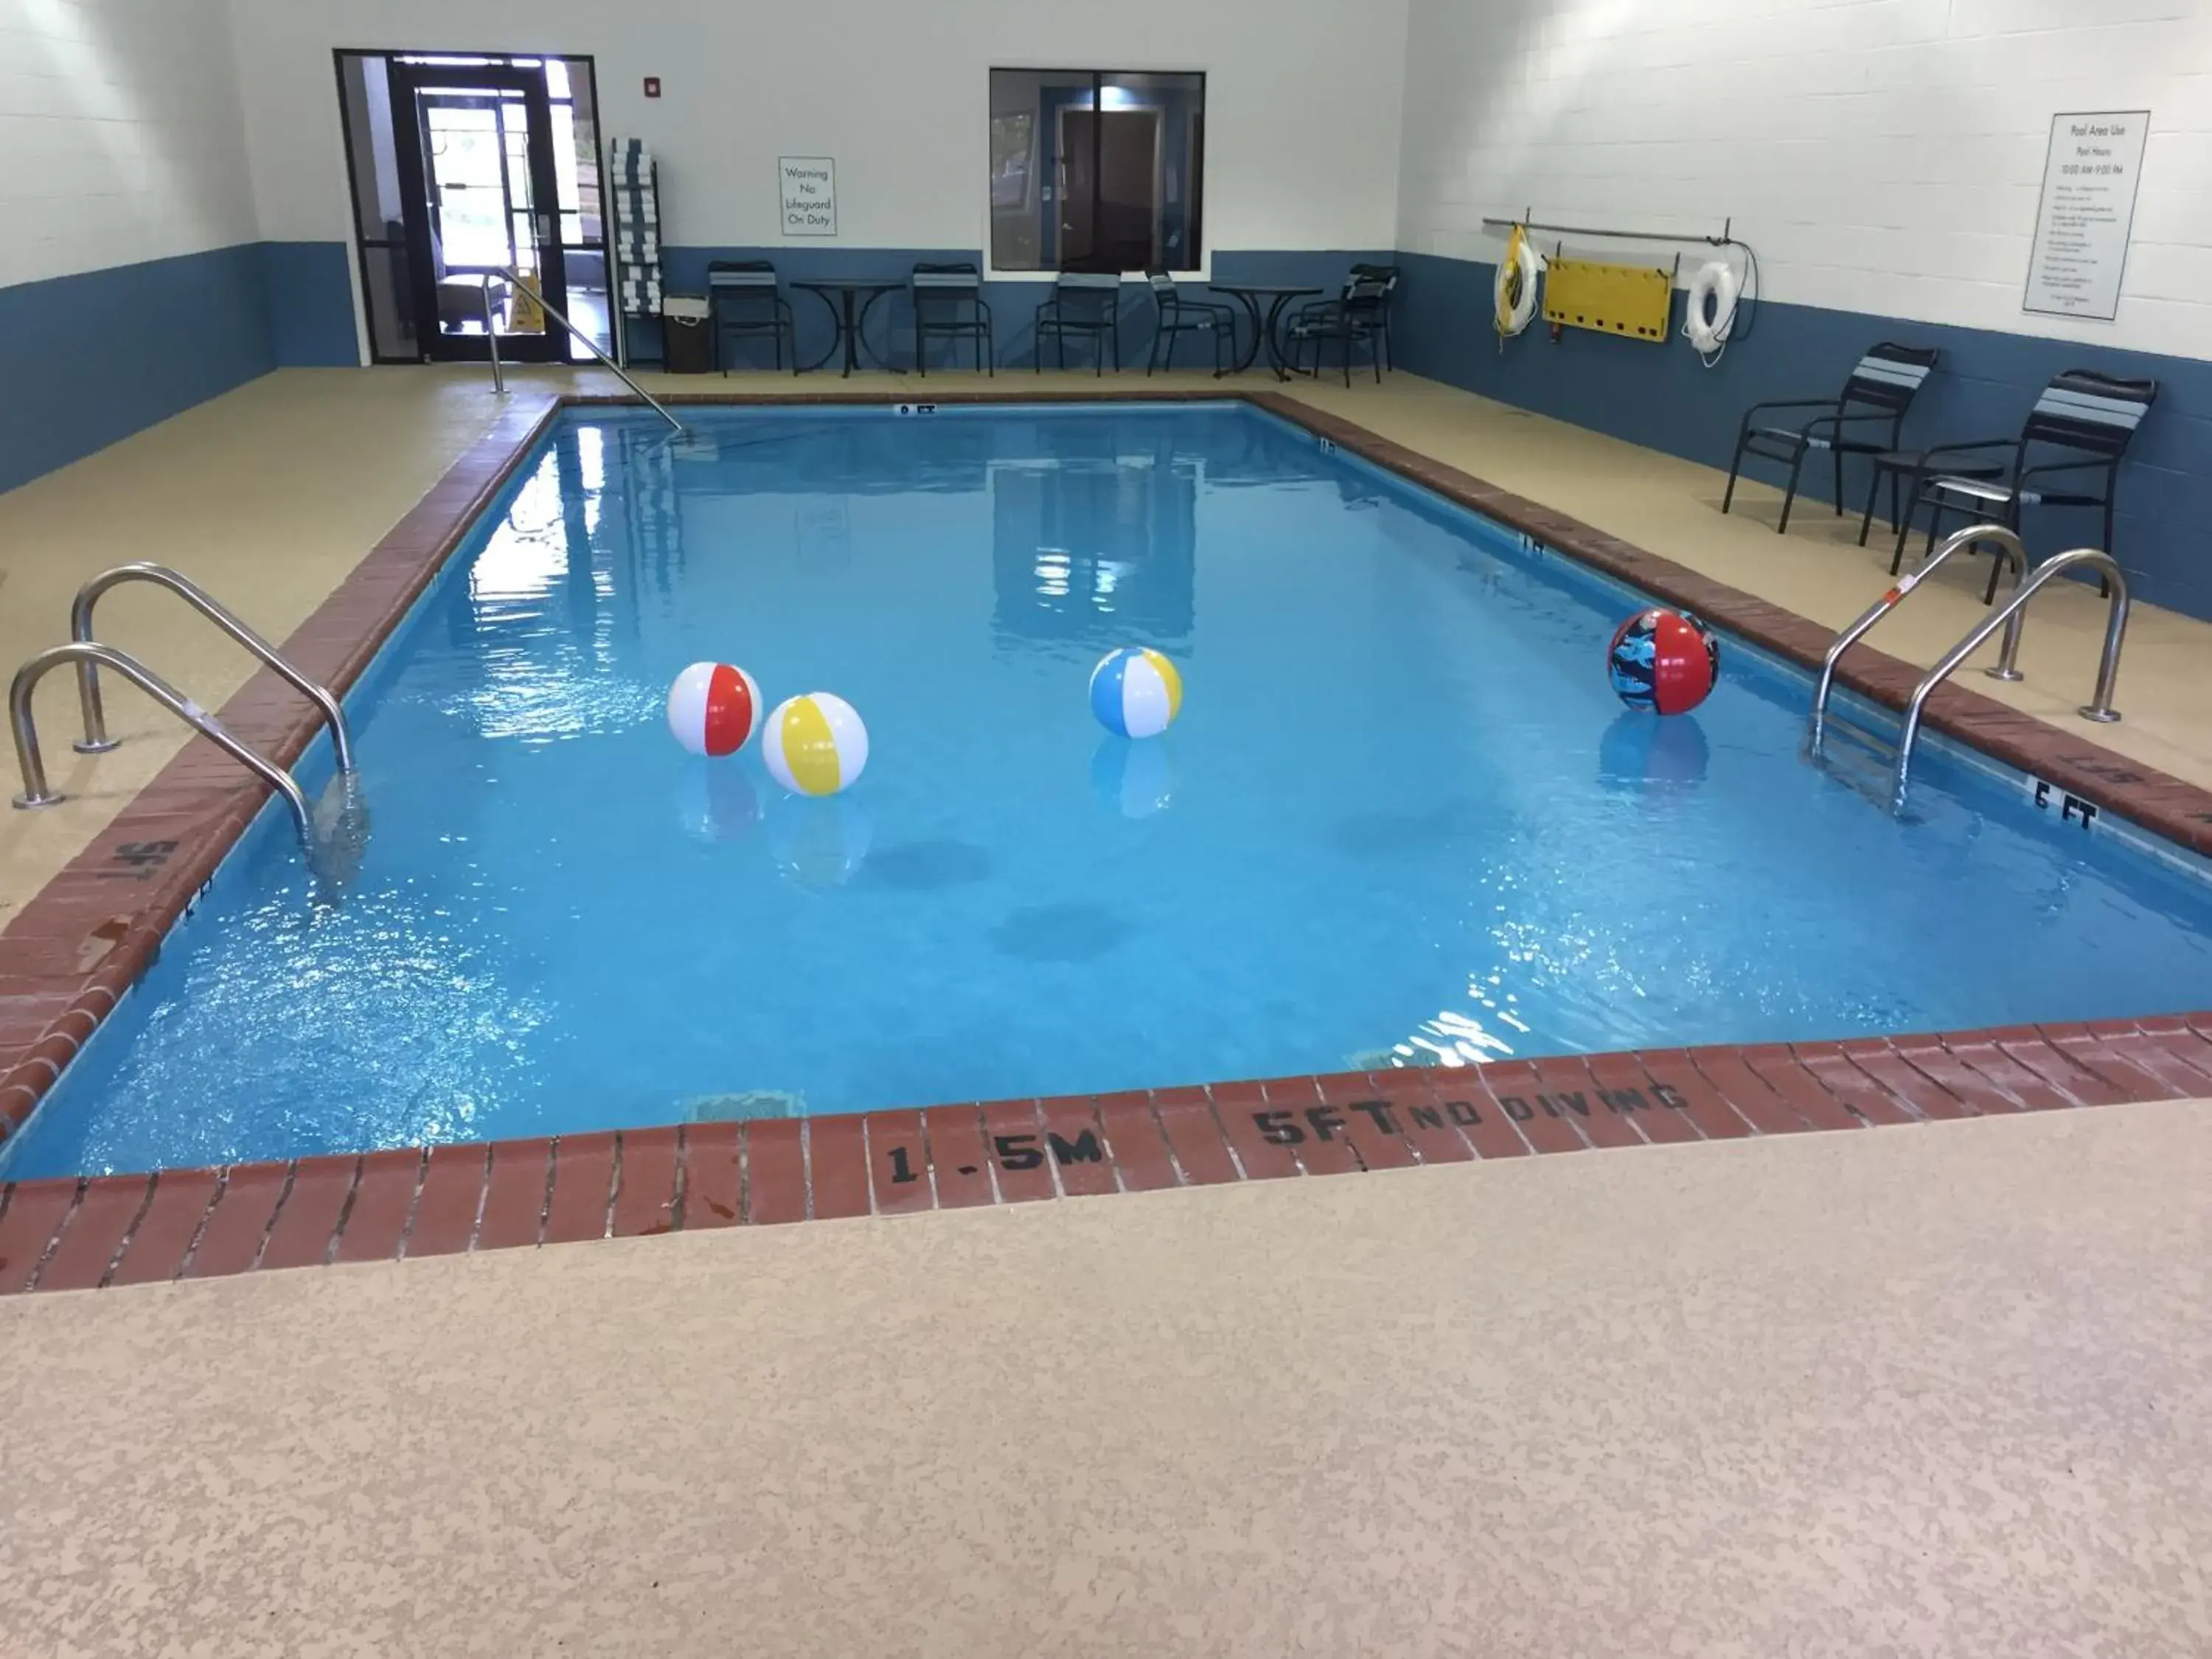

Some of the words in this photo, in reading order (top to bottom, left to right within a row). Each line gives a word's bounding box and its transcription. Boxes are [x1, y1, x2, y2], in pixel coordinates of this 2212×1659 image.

[2070, 123, 2087, 136] Pool
[785, 167, 828, 182] Warning
[800, 183, 815, 195] No
[785, 196, 831, 212] Lifeguard
[788, 213, 804, 225] On
[807, 213, 830, 226] Duty
[1408, 1102, 1483, 1130] NO
[1500, 1084, 1689, 1122] DIVING
